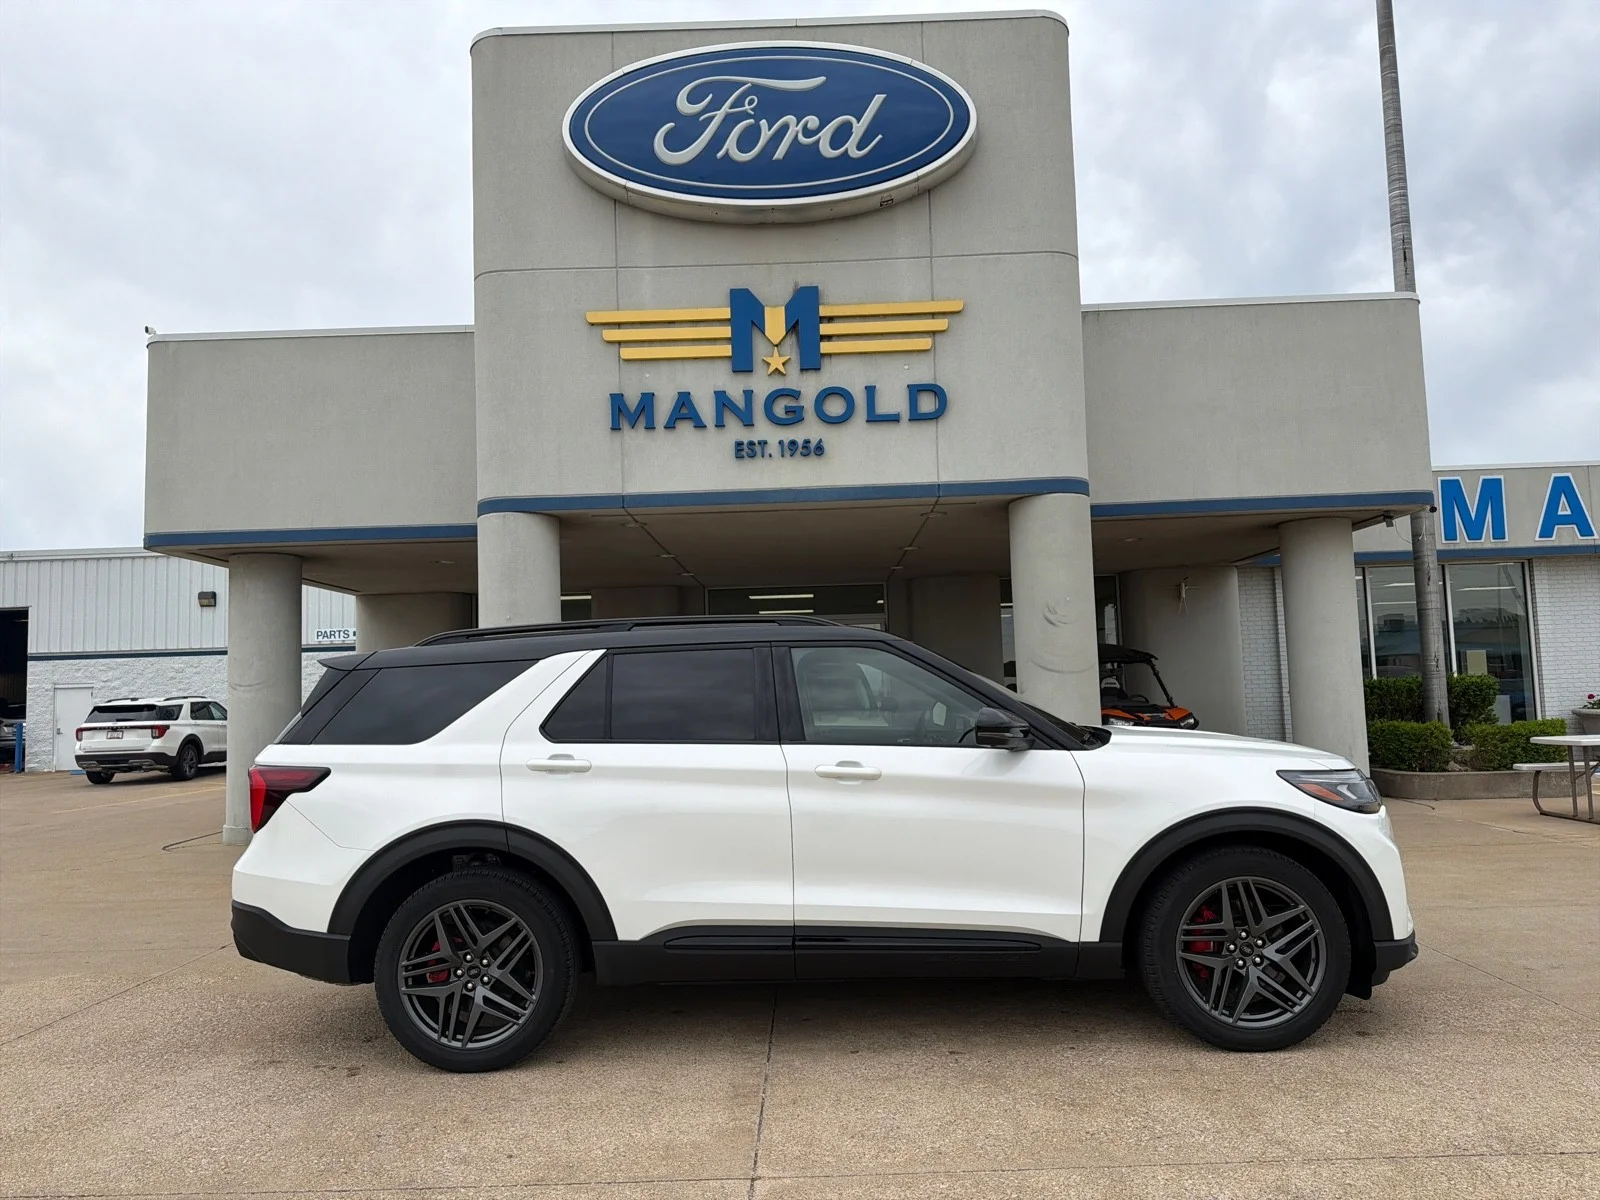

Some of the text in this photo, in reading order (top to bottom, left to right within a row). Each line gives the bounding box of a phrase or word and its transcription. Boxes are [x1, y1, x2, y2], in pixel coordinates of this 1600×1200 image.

[653, 75, 887, 166] Ford
[609, 383, 949, 431] MANGOLD
[734, 438, 825, 459] EST. 1956
[316, 630, 350, 640] PARTS
